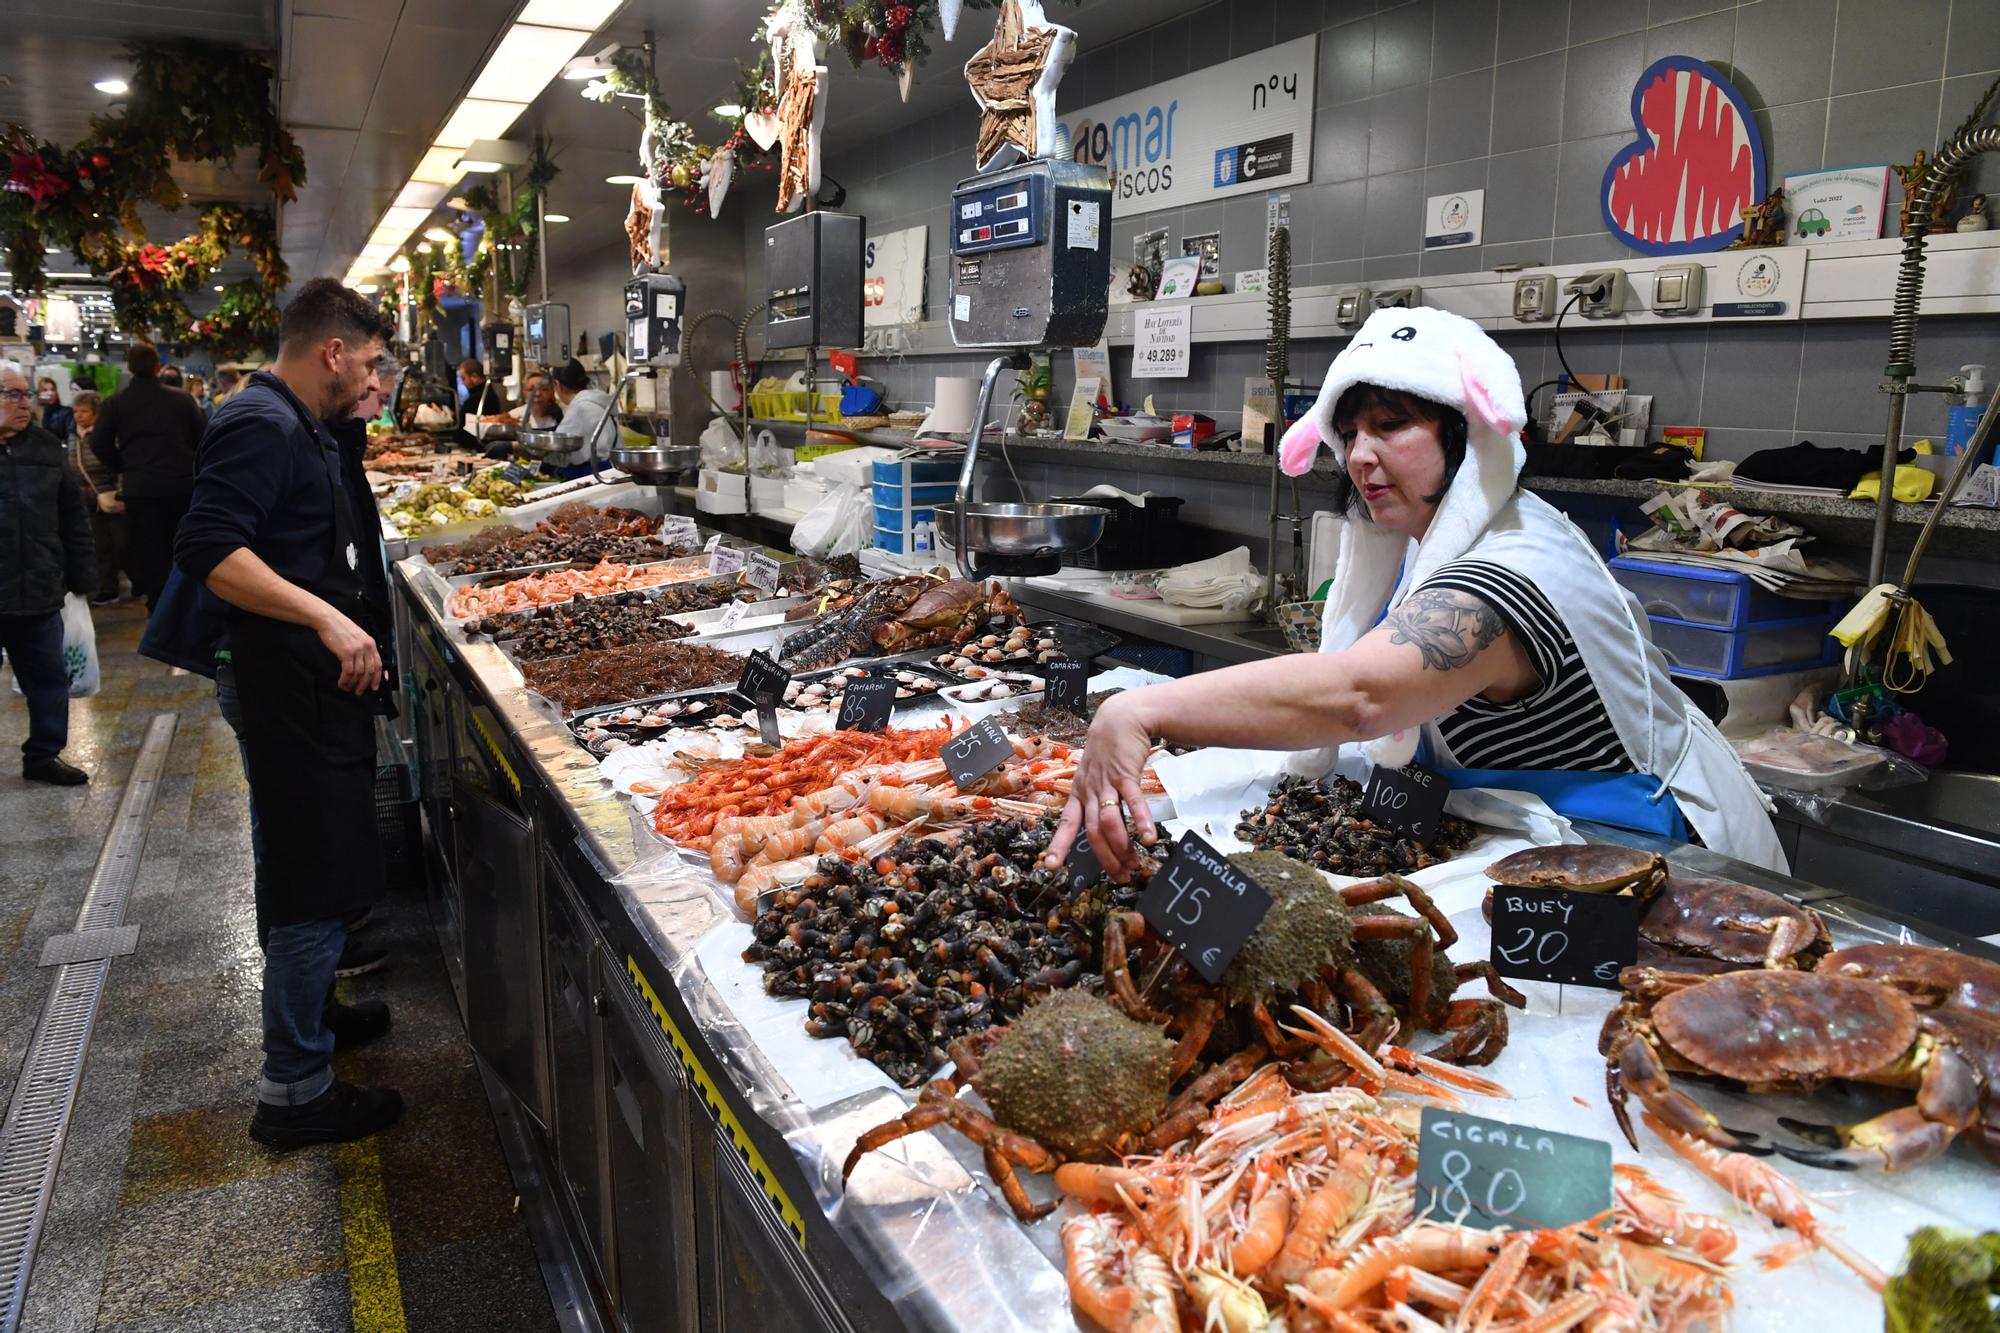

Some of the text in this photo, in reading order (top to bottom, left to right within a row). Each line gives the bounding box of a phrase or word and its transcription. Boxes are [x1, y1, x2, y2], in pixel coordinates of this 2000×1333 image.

[1147, 348, 1176, 362] 49.289
[1049, 675, 1067, 700] 70
[843, 694, 867, 722] 85
[950, 731, 982, 759] 75
[1371, 779, 1423, 834] 100 €
[1183, 841, 1247, 896] CENTOLLA
[1165, 866, 1221, 967] 45 €
[1506, 897, 1574, 924] BUEY
[1497, 927, 1618, 980] 20 €
[1431, 1121, 1555, 1155] CIGALA
[1442, 1150, 1527, 1217] 80
